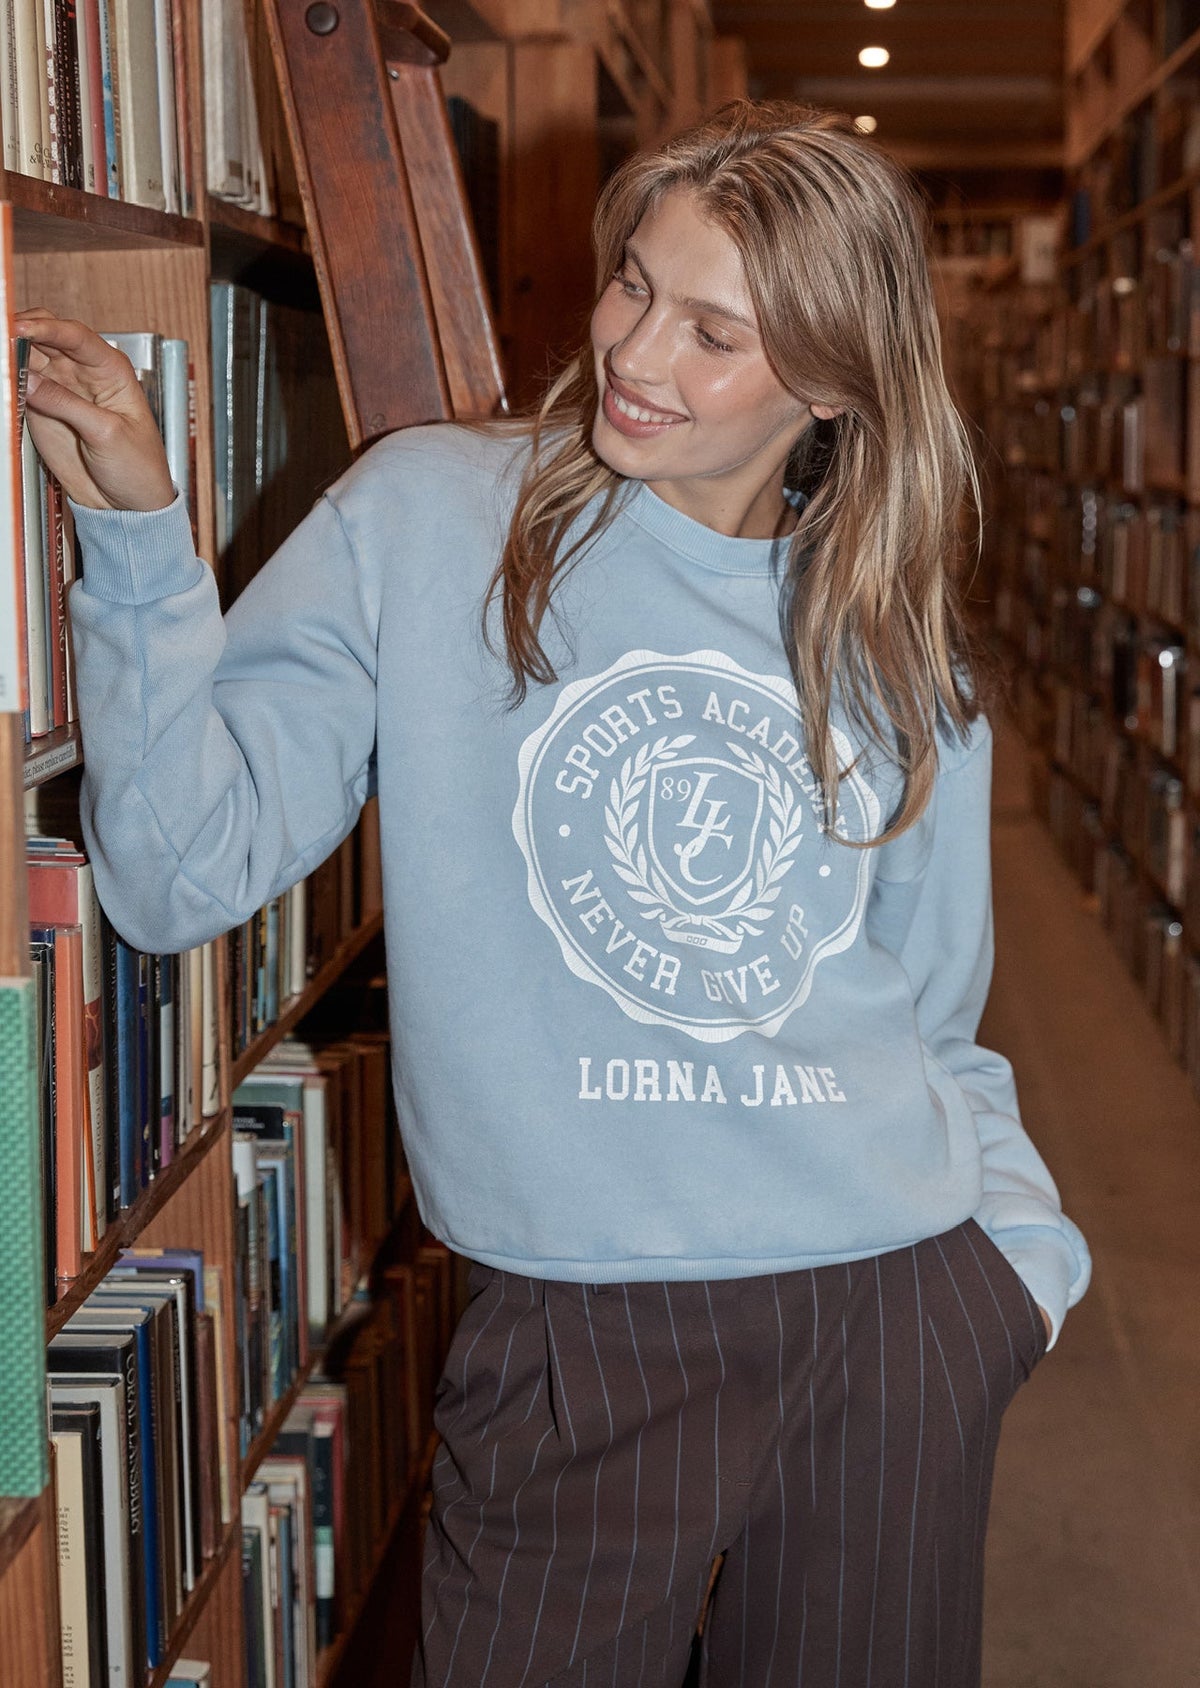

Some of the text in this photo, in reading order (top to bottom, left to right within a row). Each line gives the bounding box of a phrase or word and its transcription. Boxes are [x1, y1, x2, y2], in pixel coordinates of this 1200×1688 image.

[55, 513, 63, 571] IVORY
[555, 685, 683, 799] SPORTS
[661, 776, 692, 802] 89
[561, 869, 808, 1004] NEVER GIVE UP
[579, 1057, 847, 1107] LORNA JANE
[126, 1353, 137, 1426] CORAL
